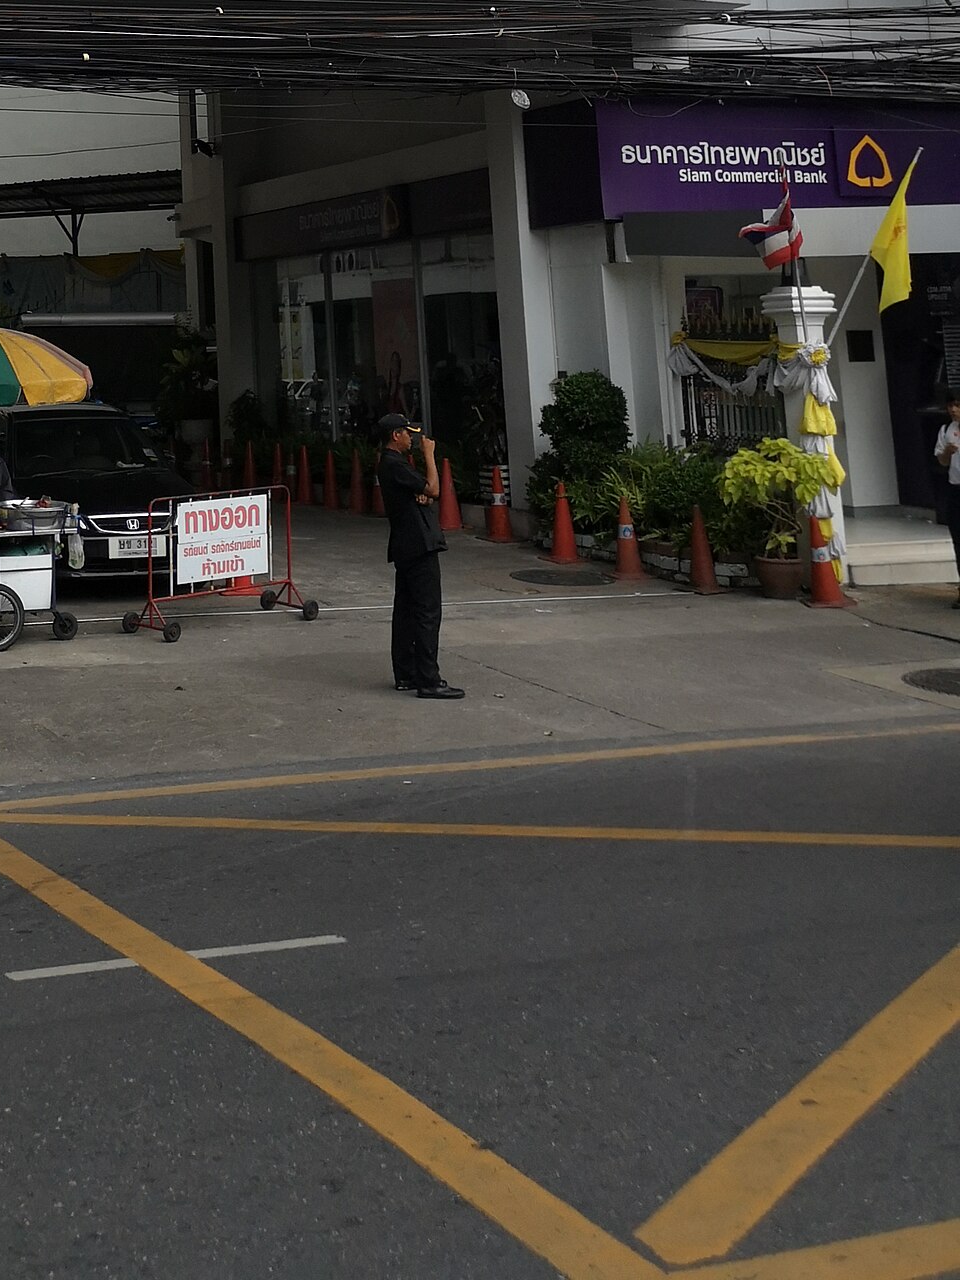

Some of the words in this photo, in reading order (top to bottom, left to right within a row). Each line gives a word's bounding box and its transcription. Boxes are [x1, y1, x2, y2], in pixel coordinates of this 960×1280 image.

[621, 142, 826, 167] ธนาคารไทยพาณิชย์
[678, 168, 712, 182] Siam
[794, 170, 828, 184] Bank
[184, 504, 260, 534] ทางออก
[184, 542, 208, 557] รถยนต์
[201, 554, 245, 576] ห้ามเข้า
